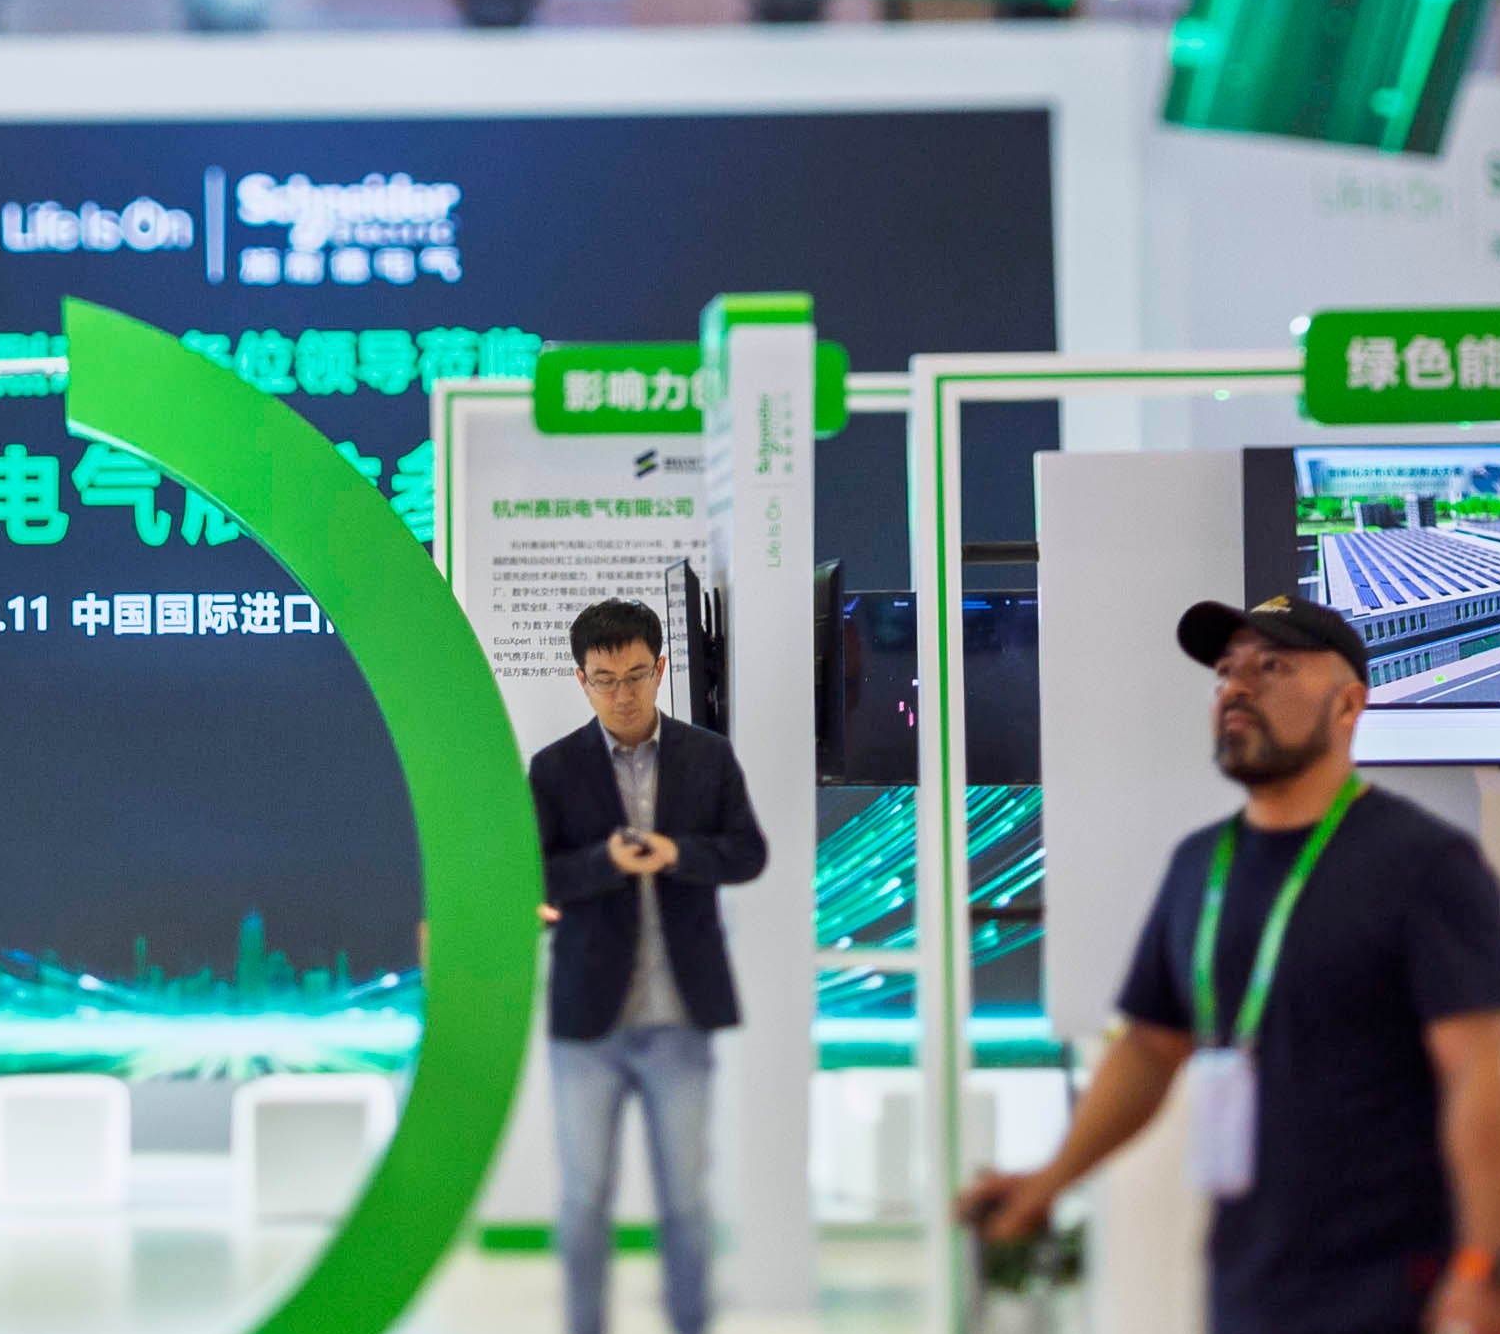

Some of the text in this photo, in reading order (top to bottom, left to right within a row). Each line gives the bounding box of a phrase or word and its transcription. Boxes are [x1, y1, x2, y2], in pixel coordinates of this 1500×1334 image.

[236, 172, 463, 232] Schneider
[71, 591, 336, 637] 中国国际进口
